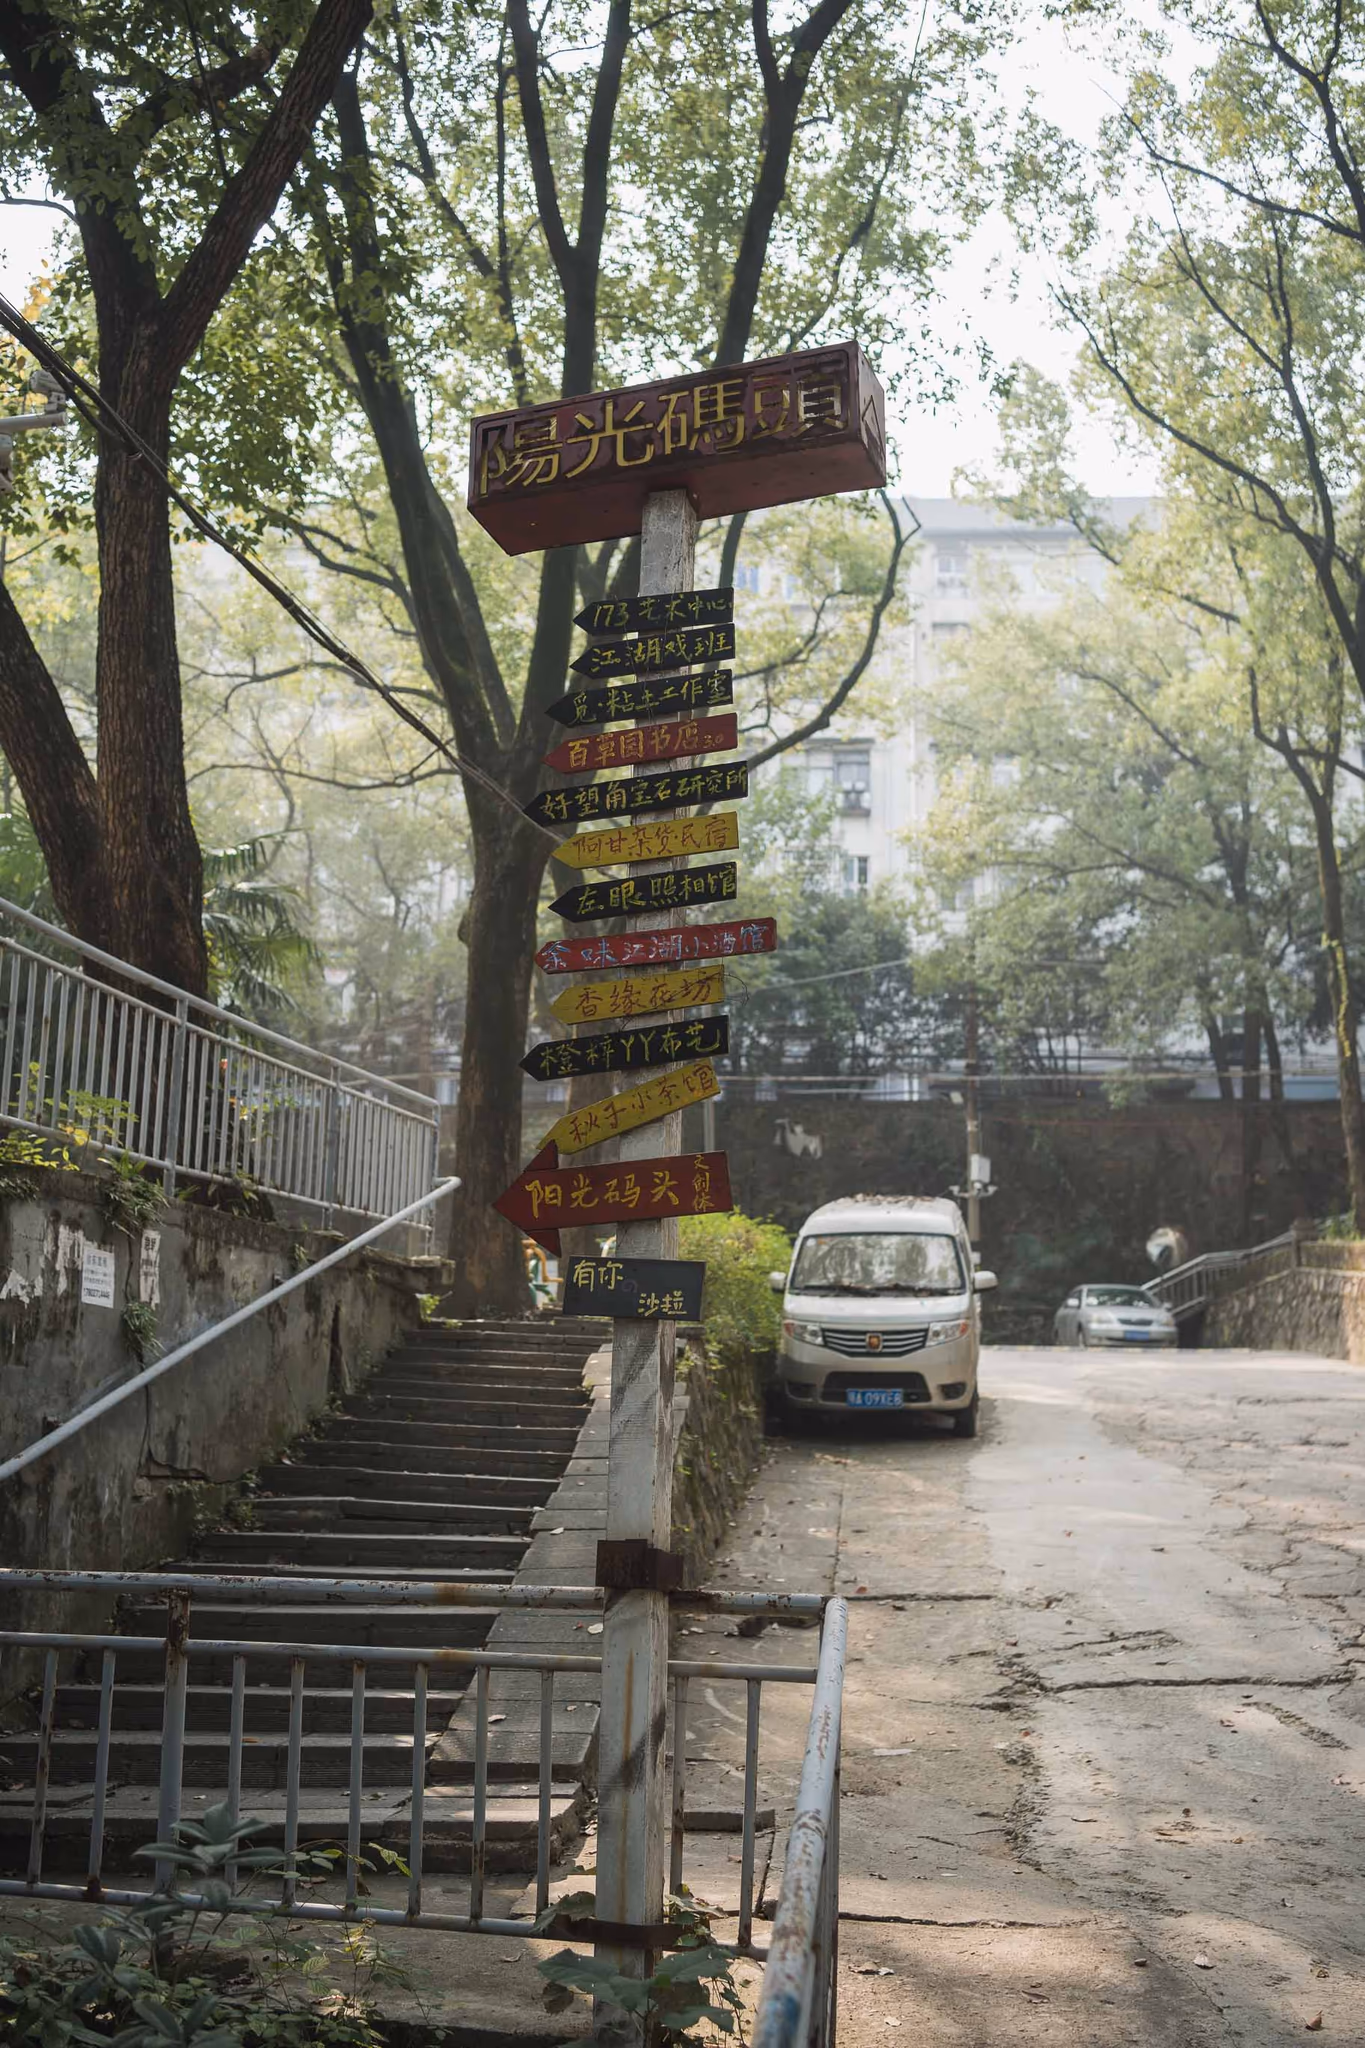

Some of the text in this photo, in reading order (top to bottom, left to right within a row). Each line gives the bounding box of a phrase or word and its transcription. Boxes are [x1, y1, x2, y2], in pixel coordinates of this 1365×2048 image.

[479, 373, 842, 498] 陽光碼頭
[591, 630, 733, 673] 江湖戏班
[576, 866, 736, 915] 左眼照相馆
[525, 1171, 680, 1219] 阳光码头
[572, 1259, 624, 1292] 有你
[637, 1289, 688, 1316] 沙拉
